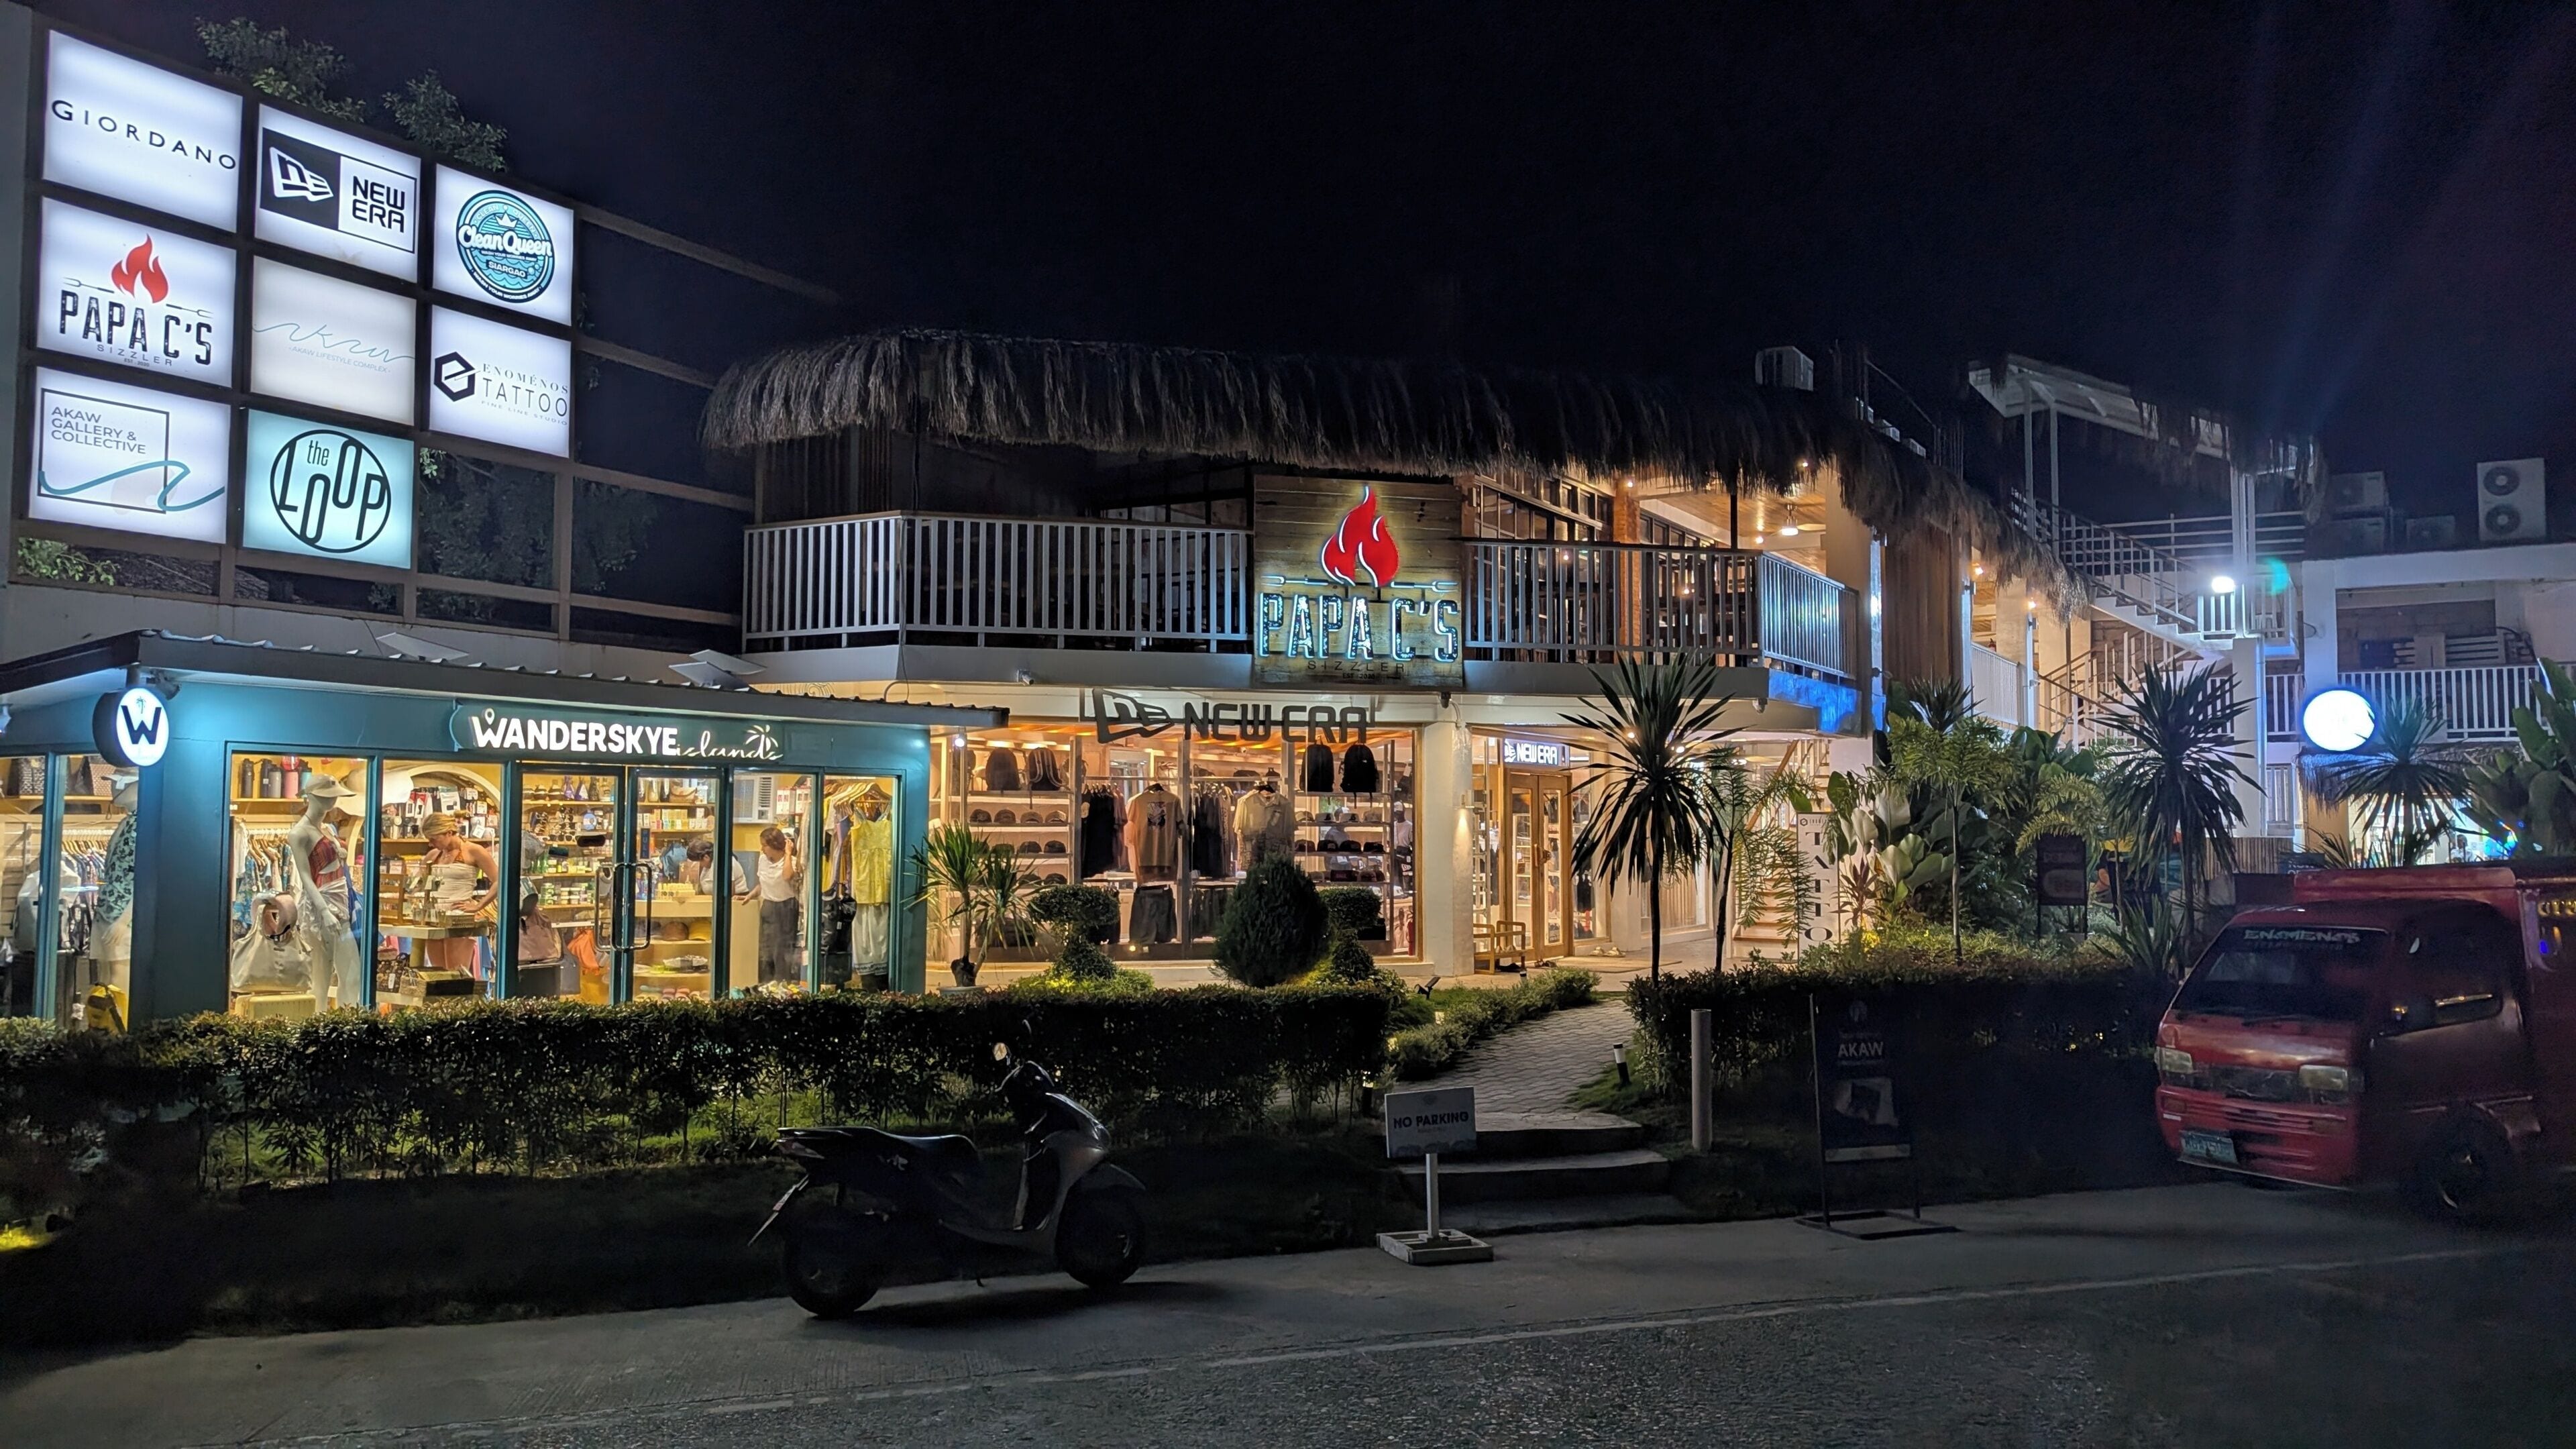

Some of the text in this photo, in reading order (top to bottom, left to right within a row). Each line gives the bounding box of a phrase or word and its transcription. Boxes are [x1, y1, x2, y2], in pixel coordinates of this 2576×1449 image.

[52, 100, 236, 169] GIORDANO
[352, 176, 405, 211] NEW
[352, 199, 404, 233] ERA
[488, 261, 526, 278] SIARGAO
[488, 285, 503, 297] YOUR
[60, 289, 213, 366] PAPA C'S
[97, 344, 172, 366] SIZZLER
[292, 346, 387, 373] AKAW LIFESTYLE COMPLEX
[483, 377, 568, 417] TATTOO
[52, 407, 101, 423] AKAW
[482, 400, 568, 425] FINE LINE STUDIO
[51, 418, 137, 441] GALLERY &
[51, 430, 146, 454] COLLECTIVE
[307, 439, 329, 466] the
[277, 439, 388, 544] LOOP
[1260, 592, 1460, 663] PAPA C'S
[1308, 661, 1405, 672] SIZZLER
[121, 705, 162, 745] W
[471, 714, 678, 756] WANDERSKYE
[1184, 702, 1367, 743] NEW ERA
[1517, 743, 1558, 765] NEW ERA
[1837, 1041, 1884, 1058] AKAW
[1393, 1112, 1468, 1128] NO PARKING
